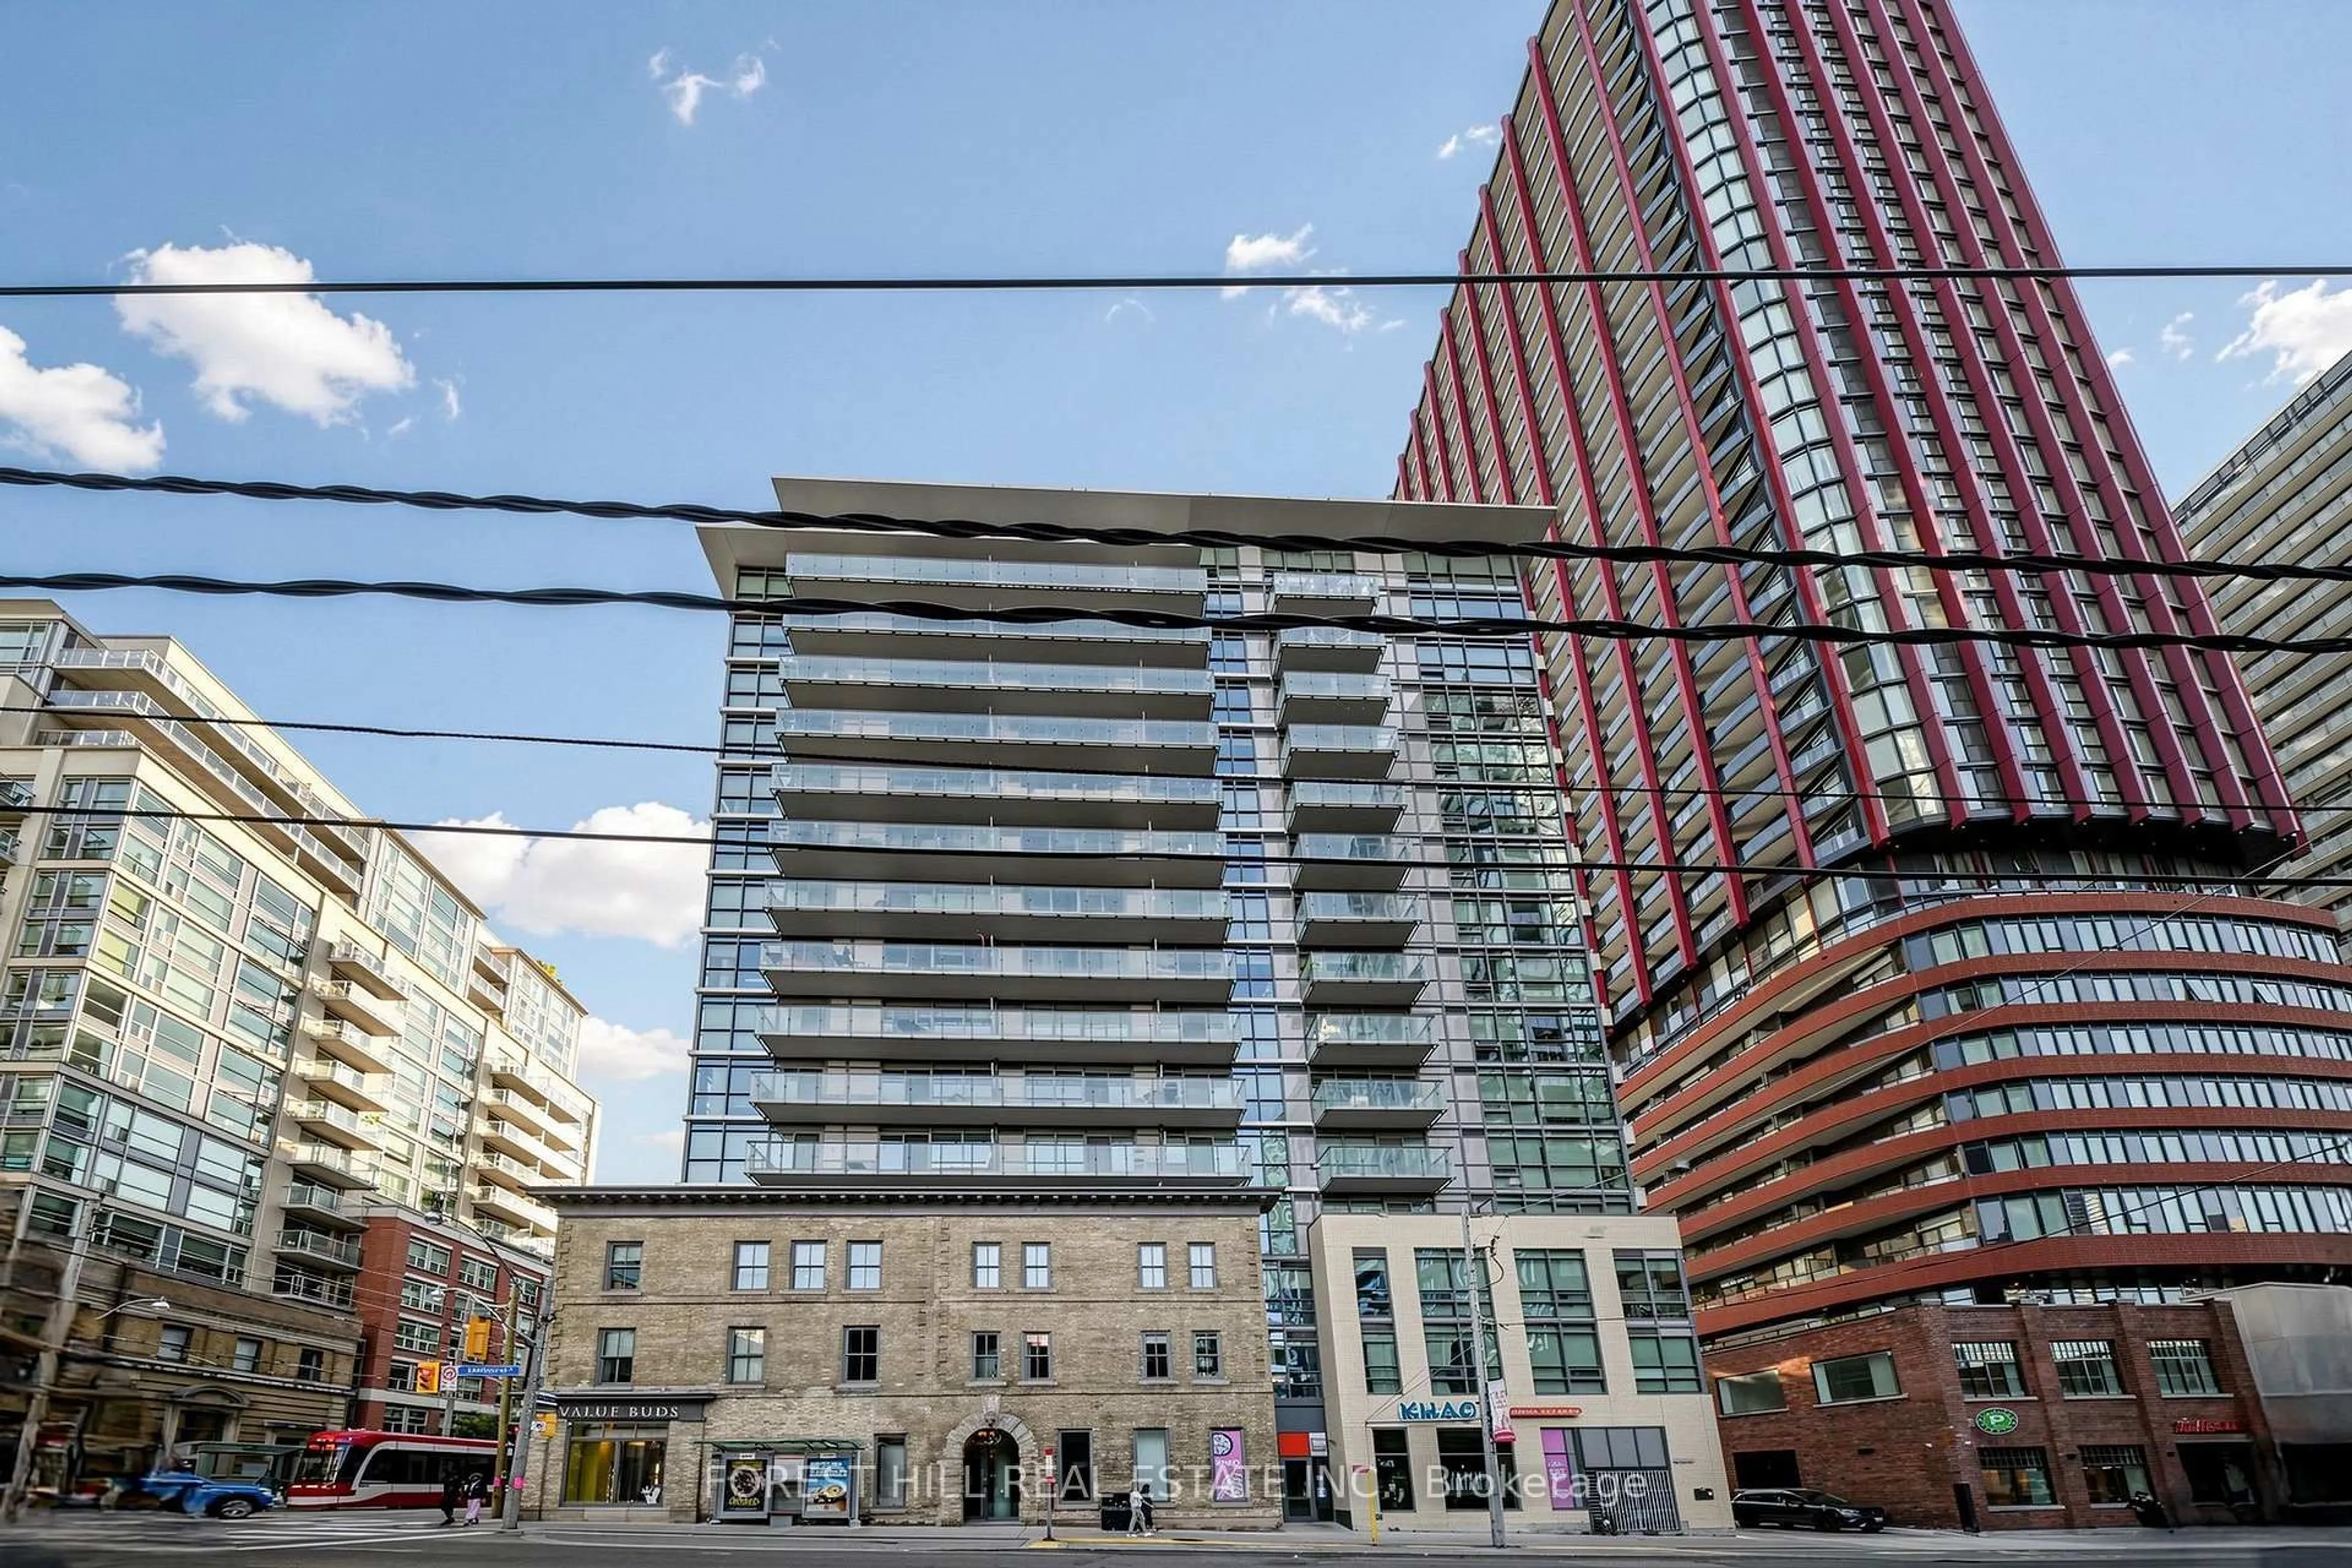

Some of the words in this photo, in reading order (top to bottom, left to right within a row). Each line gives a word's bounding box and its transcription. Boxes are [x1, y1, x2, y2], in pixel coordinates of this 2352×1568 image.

[559, 1406, 619, 1417] VALUE
[629, 1406, 679, 1417] BUDS
[1400, 1401, 1477, 1419] KHAO
